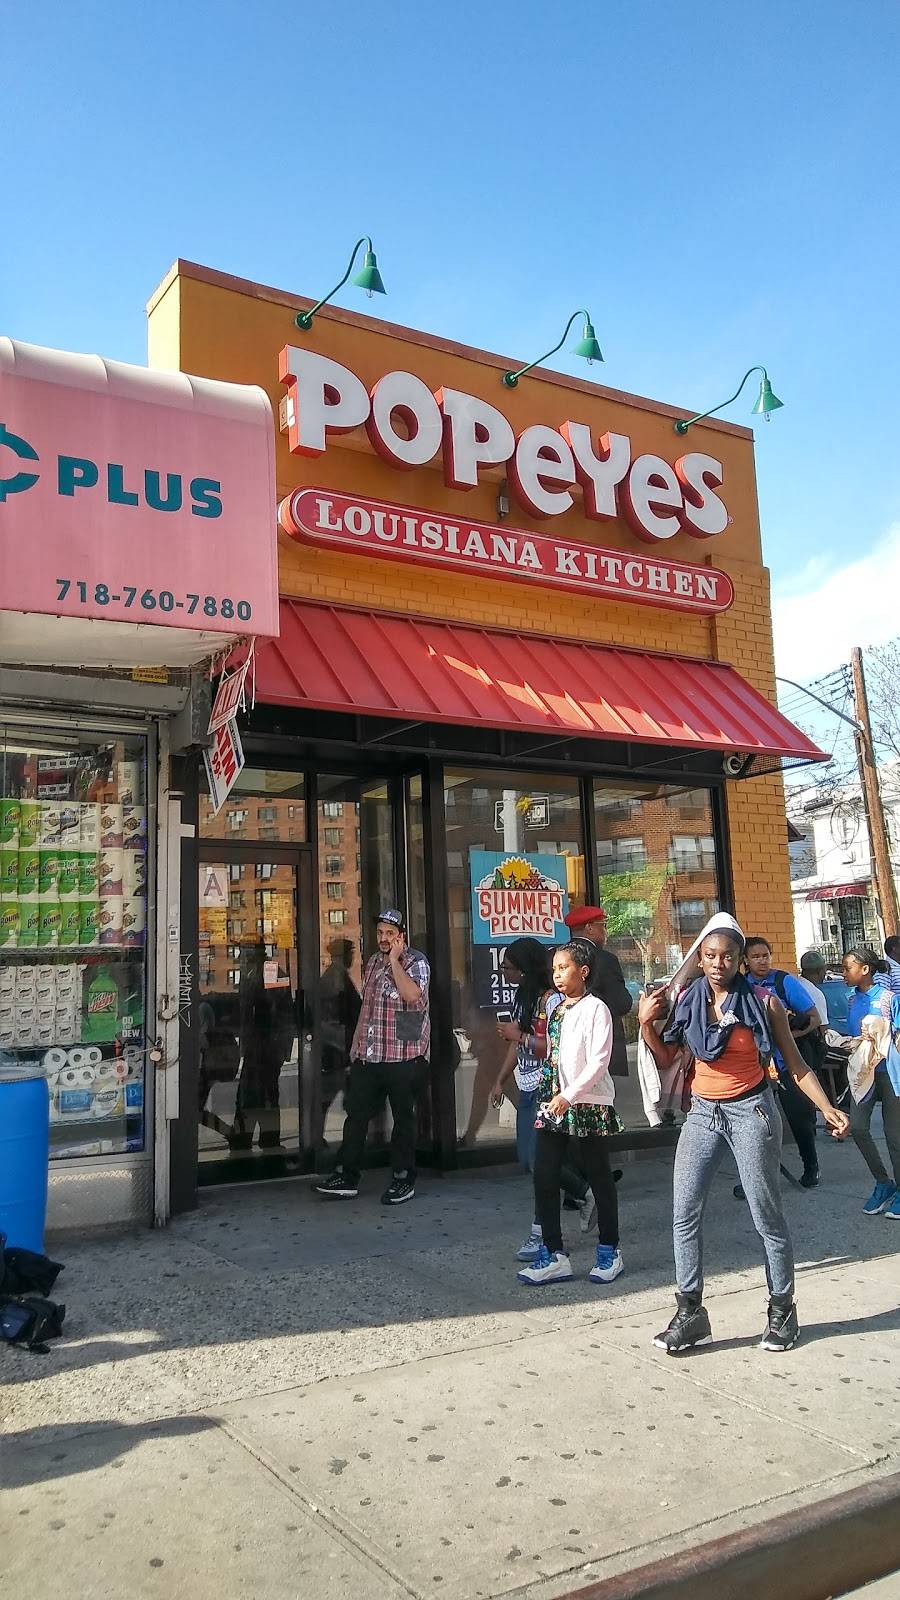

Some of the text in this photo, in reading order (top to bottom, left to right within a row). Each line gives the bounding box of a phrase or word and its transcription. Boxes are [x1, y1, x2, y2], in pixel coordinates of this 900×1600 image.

[57, 454, 223, 519] PLUS
[314, 498, 720, 602] LOUISIANA KITCHEN
[55, 578, 253, 621] 718-760-7880
[203, 872, 223, 896] A
[480, 891, 562, 920] SUMMER
[491, 915, 553, 933] PICNIC
[491, 974, 499, 988] 2
[492, 990, 500, 1004] 5
